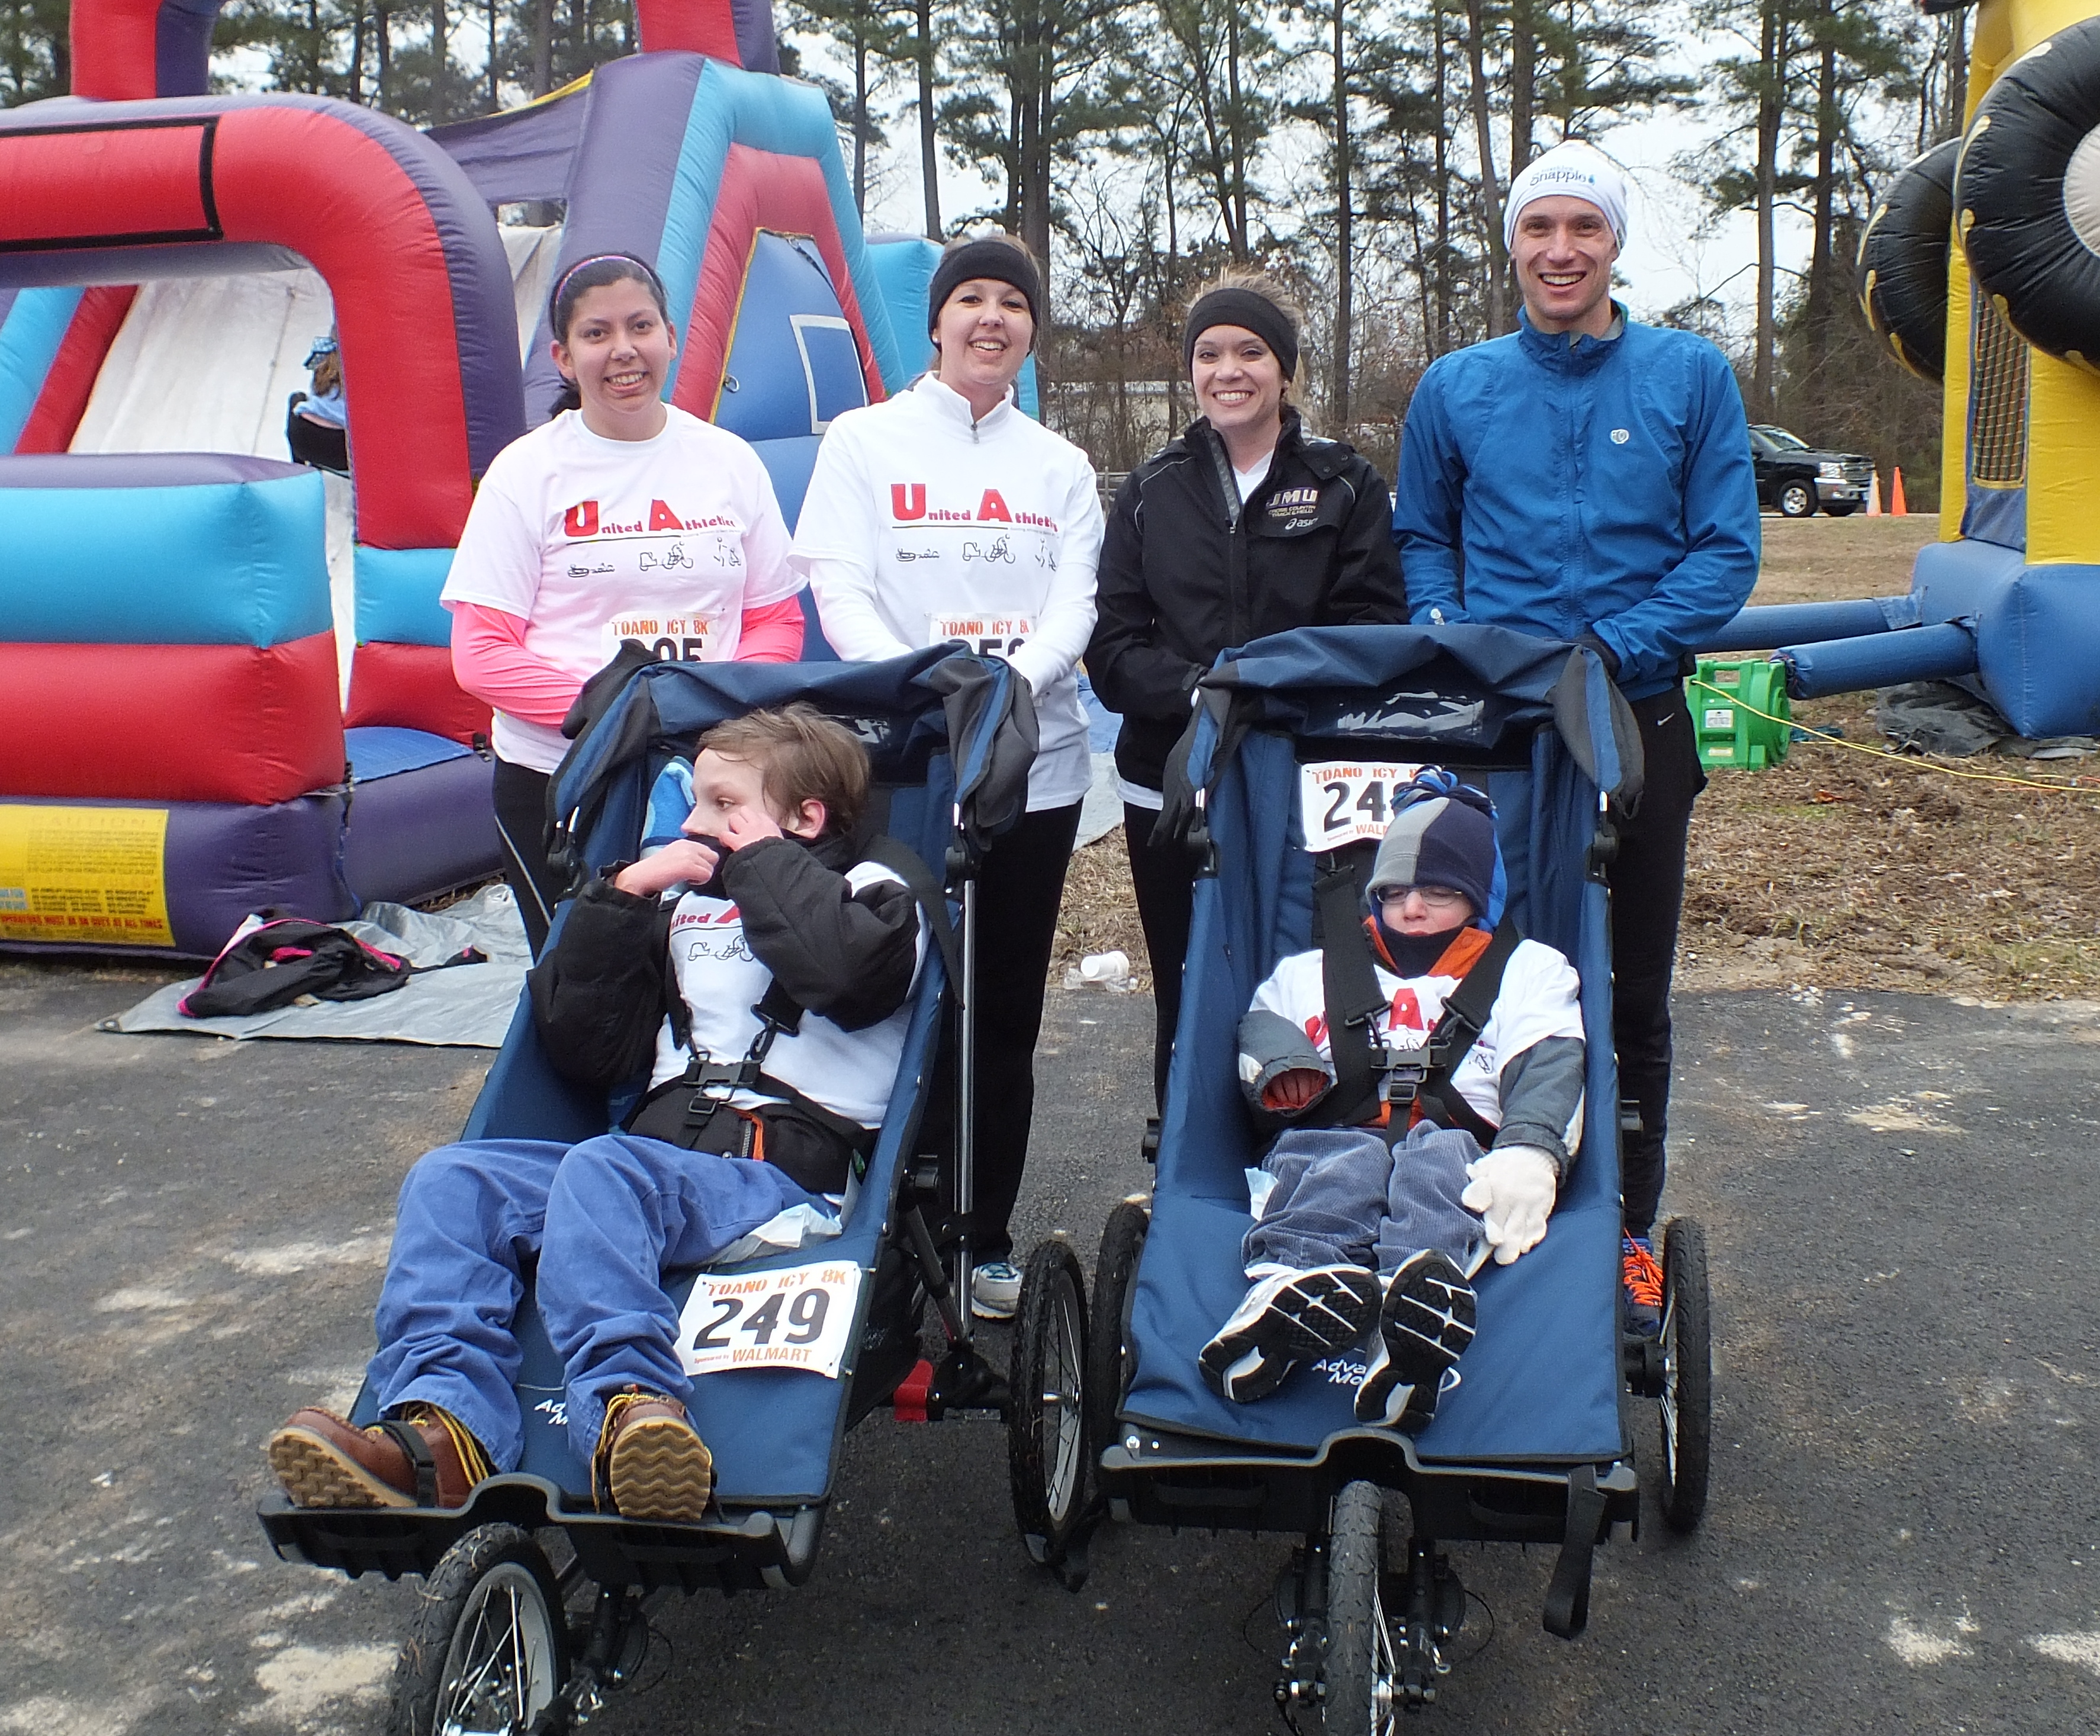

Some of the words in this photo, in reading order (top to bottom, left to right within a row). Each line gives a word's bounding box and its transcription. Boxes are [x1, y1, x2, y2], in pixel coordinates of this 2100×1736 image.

[891, 484, 970, 520] United
[1266, 489, 1318, 506] JMU
[564, 500, 642, 537] United
[612, 619, 658, 636] TOANO
[667, 619, 686, 634] ICY
[693, 619, 708, 635] 8K
[940, 620, 983, 636] TOANO
[992, 620, 1012, 635] ICY
[1312, 767, 1362, 784] TOANO
[1372, 769, 1397, 778] ICY
[709, 1279, 767, 1296] TOANO
[777, 1272, 810, 1289] ICY
[821, 1269, 847, 1285] 8K
[693, 1288, 830, 1351] 249
[732, 1347, 812, 1363] WALMART
[1311, 1358, 1366, 1375] Adva
